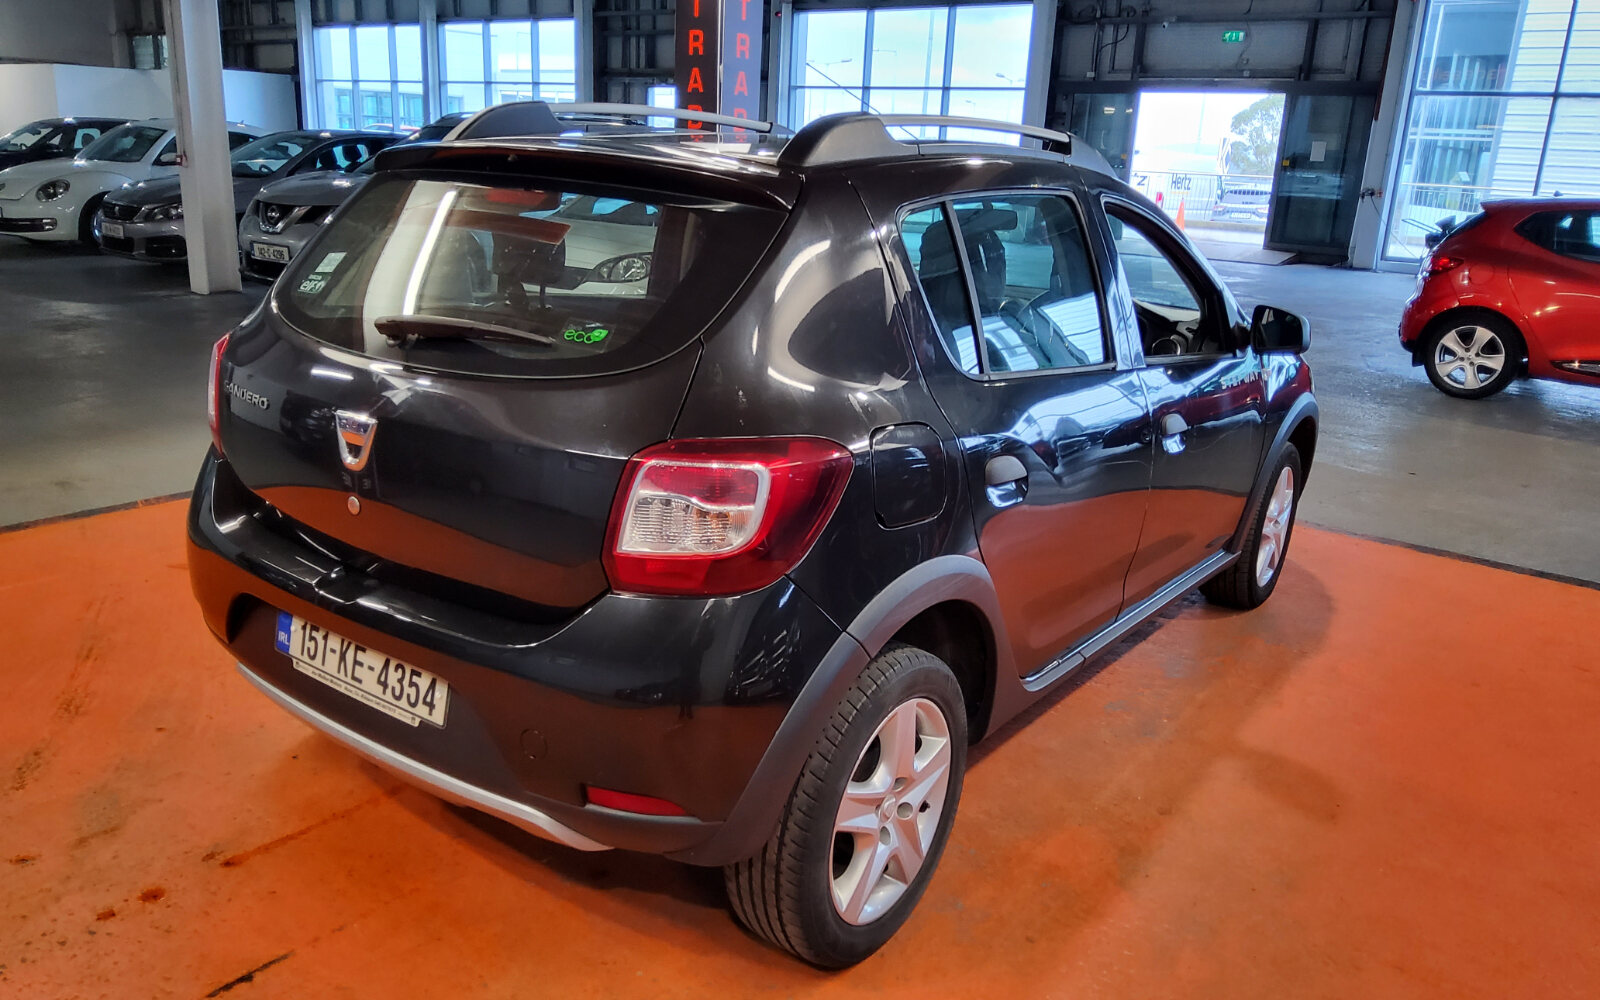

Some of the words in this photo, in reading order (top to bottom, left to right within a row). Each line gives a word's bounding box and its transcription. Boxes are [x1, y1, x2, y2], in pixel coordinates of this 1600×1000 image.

[1171, 173, 1192, 191] Hertz
[277, 630, 290, 645] IRL
[300, 621, 438, 716] 151-KE-4354
